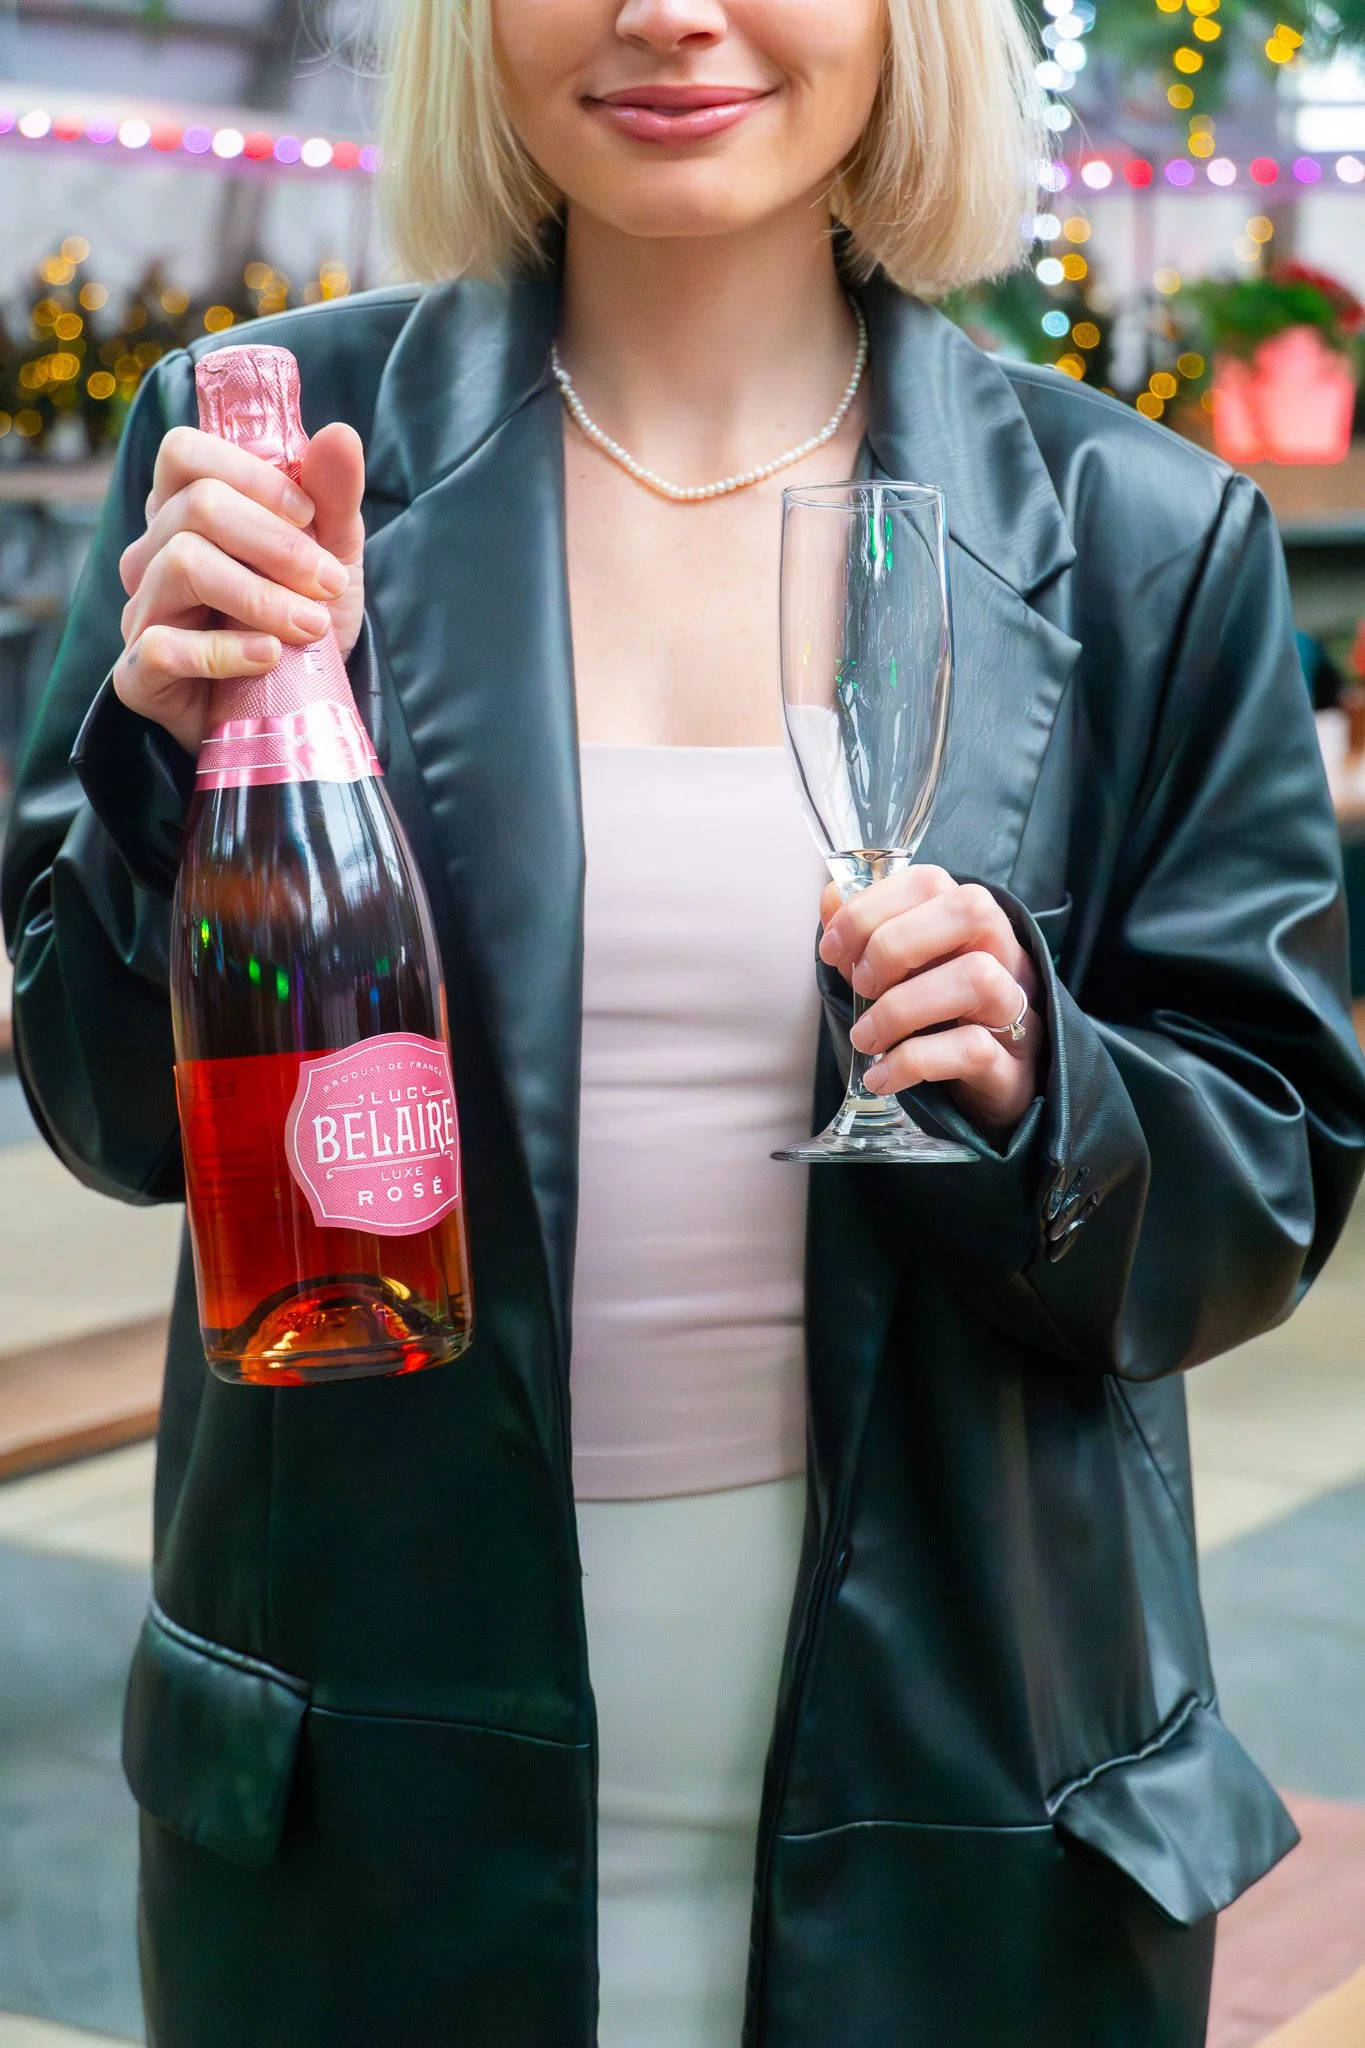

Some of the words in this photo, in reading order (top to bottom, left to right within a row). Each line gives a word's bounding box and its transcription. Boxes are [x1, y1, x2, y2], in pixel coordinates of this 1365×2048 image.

[322, 1065, 381, 1093] PRODUIT
[388, 1062, 402, 1071] DE
[409, 1061, 443, 1077] FRANCE
[371, 1086, 418, 1105] LUC
[312, 1098, 455, 1164] BELAIRE
[381, 1166, 423, 1181] LUXE
[358, 1175, 442, 1206] ROSÉ
